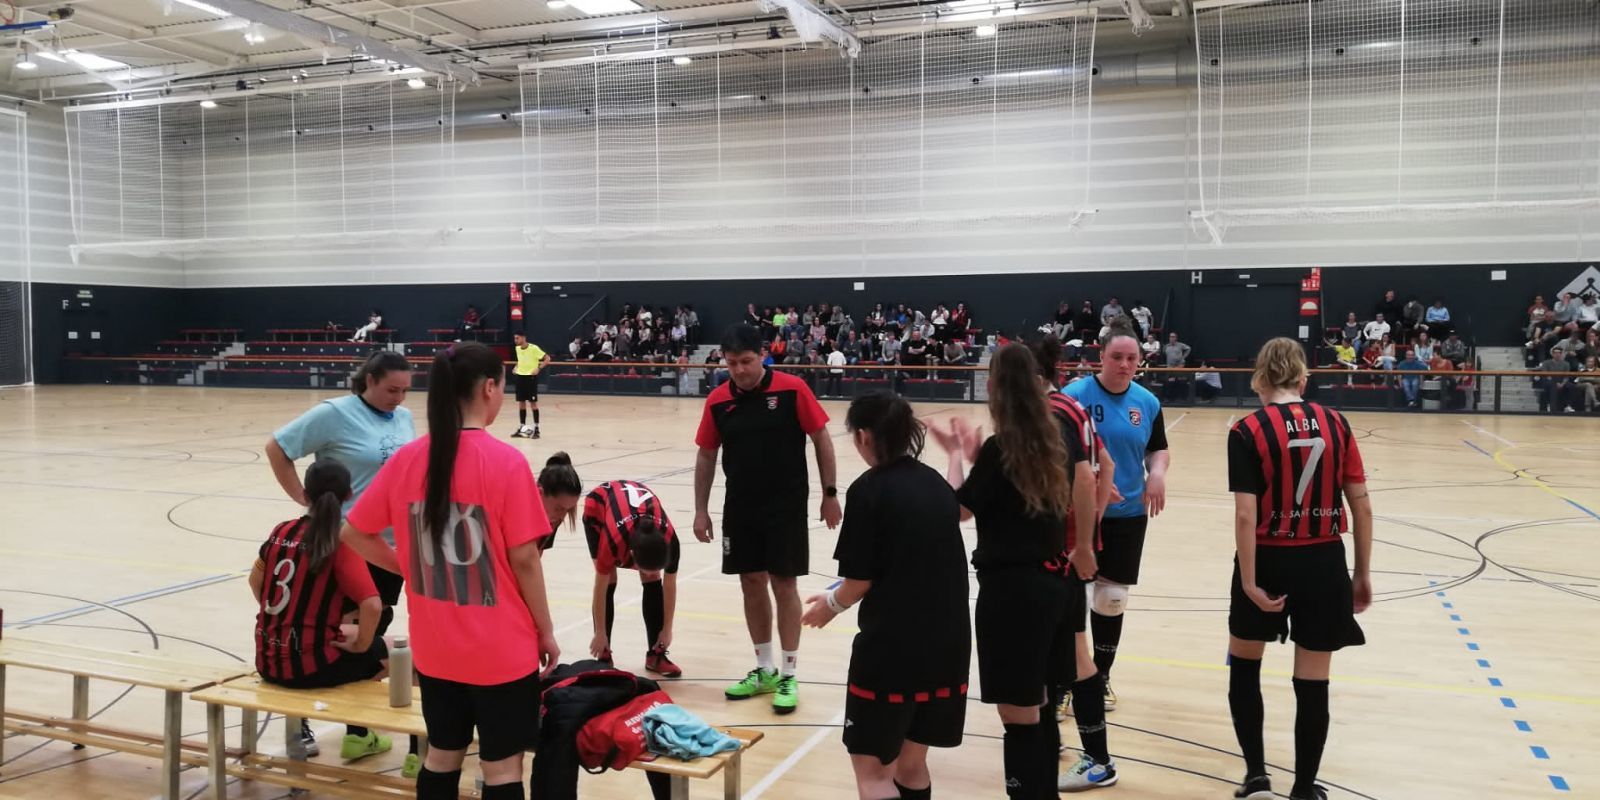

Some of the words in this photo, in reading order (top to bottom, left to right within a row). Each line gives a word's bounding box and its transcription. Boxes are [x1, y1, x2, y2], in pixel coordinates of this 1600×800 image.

[1191, 271, 1202, 284] H
[523, 283, 531, 294] G
[62, 299, 70, 310] F
[1086, 404, 1105, 423] 19
[1285, 418, 1320, 433] ALBA
[1287, 436, 1326, 506] 7
[1289, 508, 1310, 519] SANT
[1312, 507, 1344, 517] CUGAT
[264, 558, 296, 616] 3
